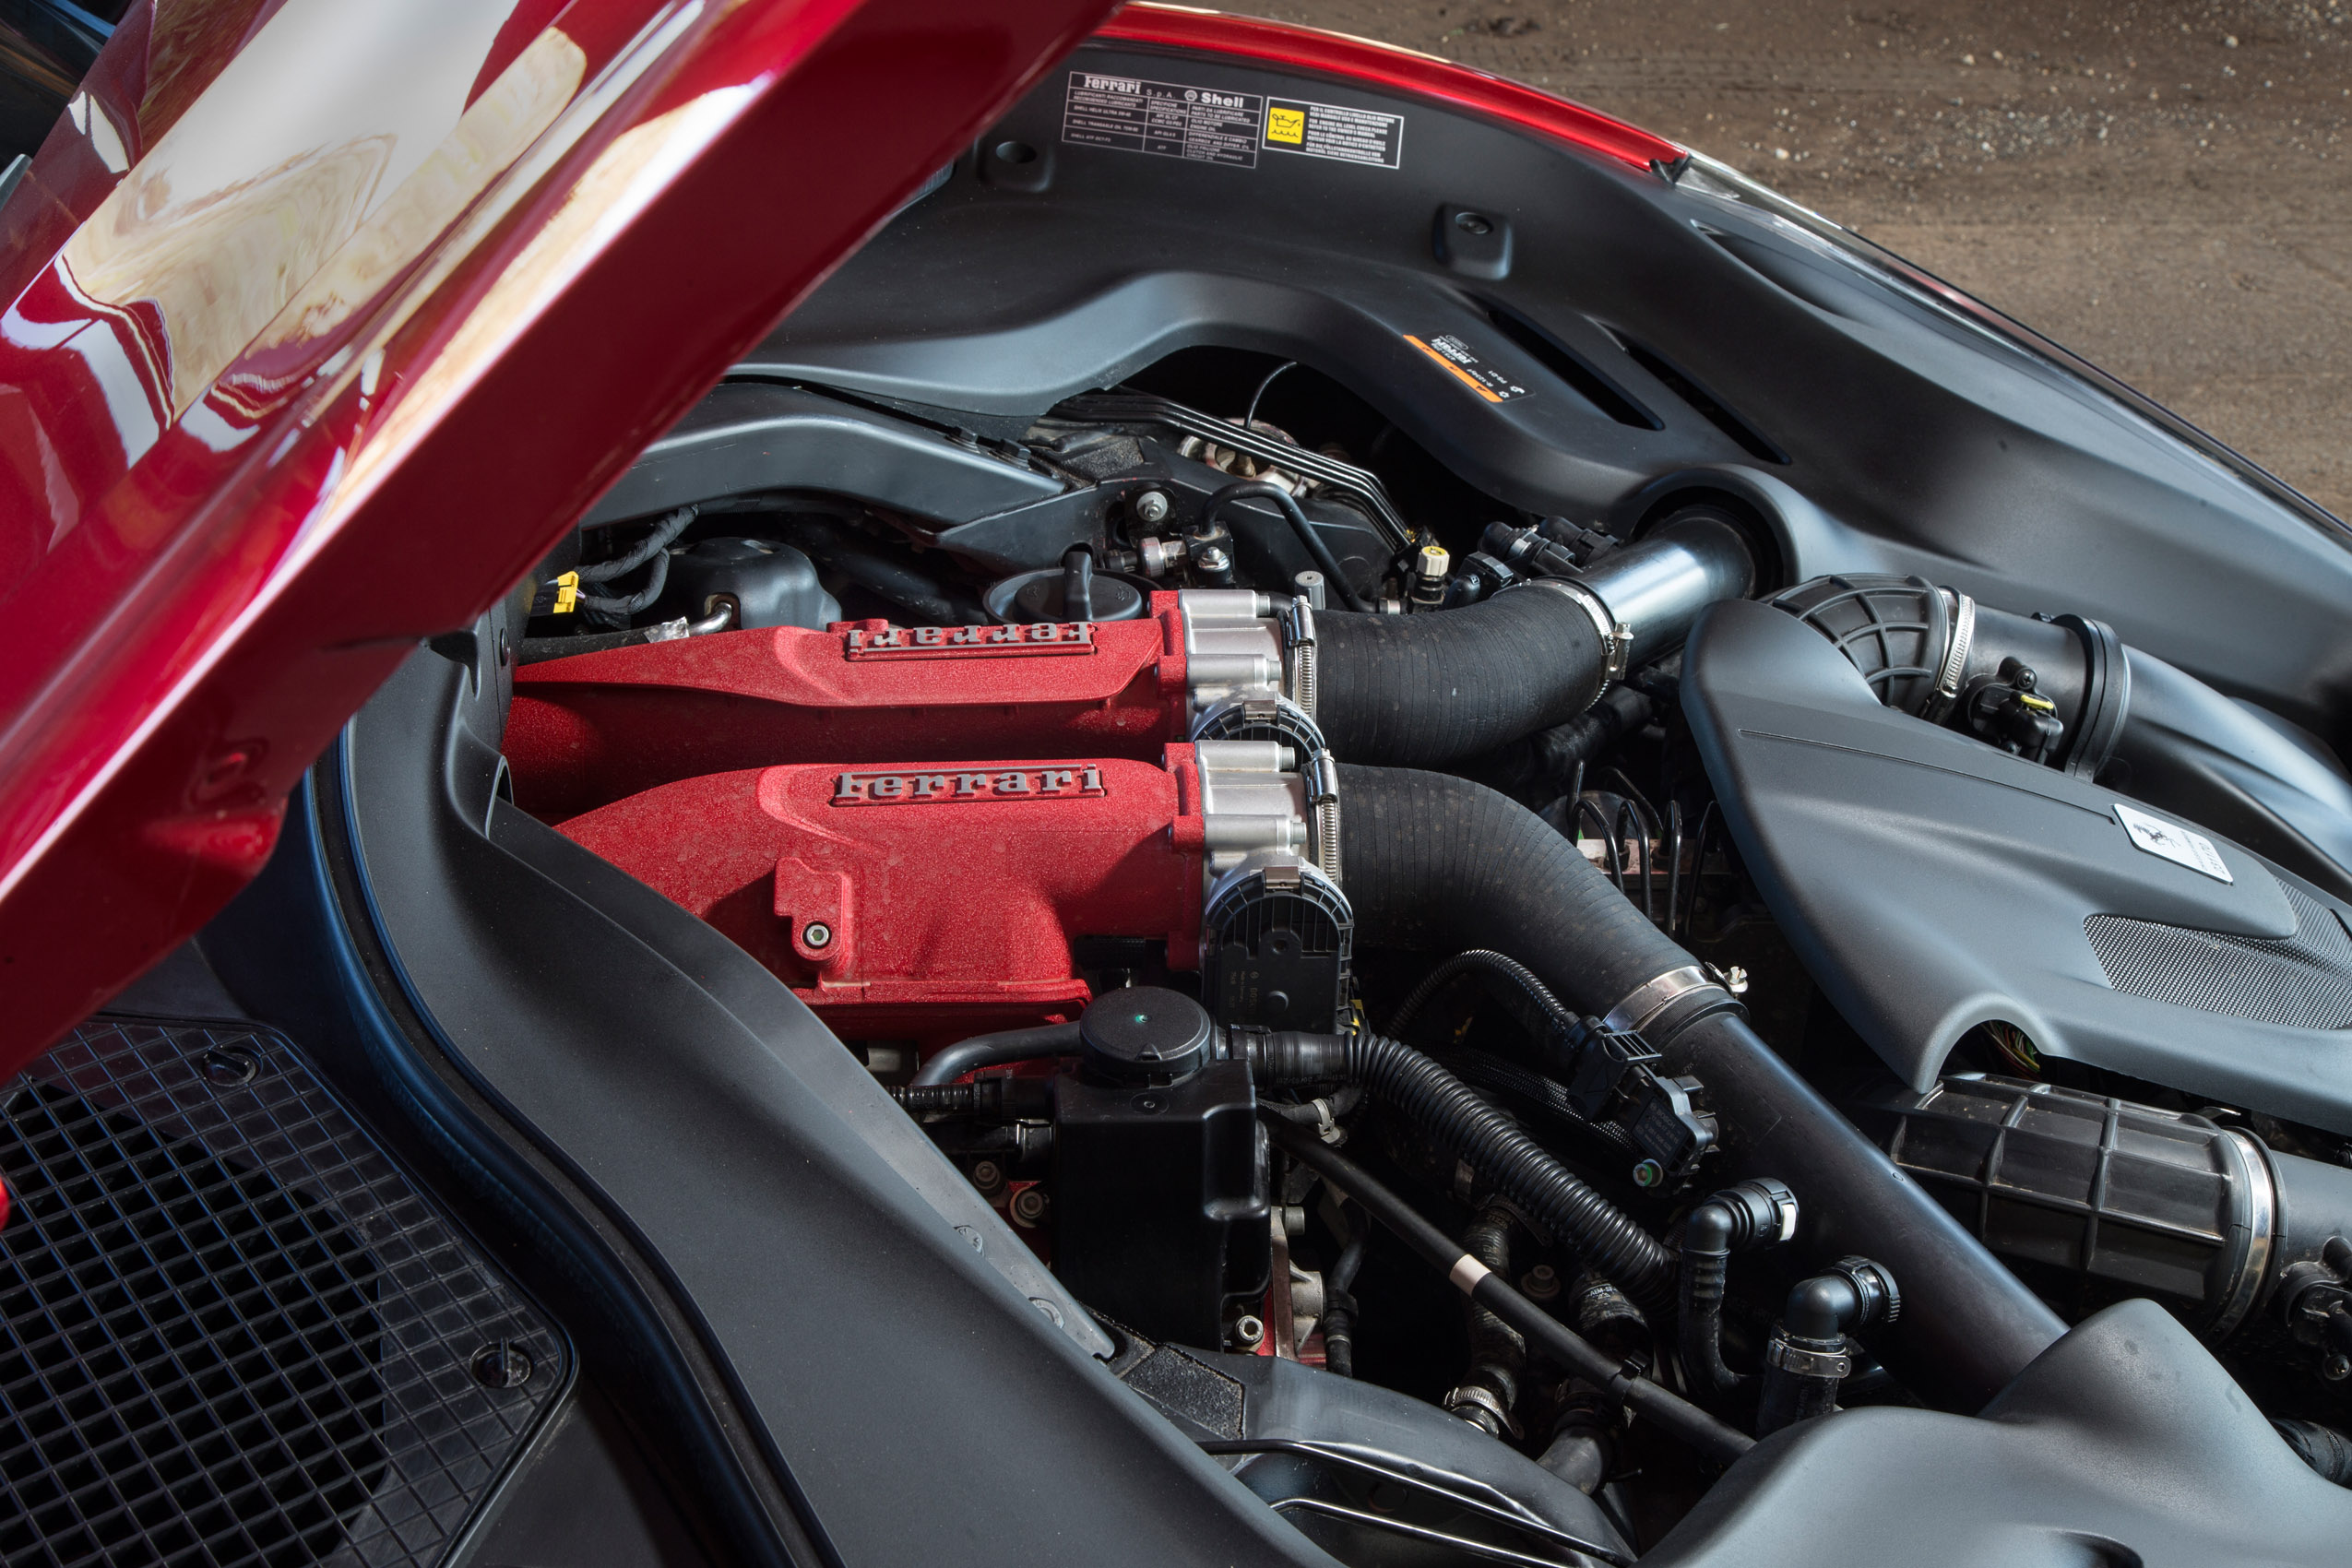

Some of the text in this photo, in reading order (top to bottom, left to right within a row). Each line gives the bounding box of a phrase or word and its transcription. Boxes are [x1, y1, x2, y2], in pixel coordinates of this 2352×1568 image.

[1084, 75, 1175, 100] Ferrari S.p.A.
[1201, 92, 1244, 108] Shell
[847, 622, 1094, 653] Ferrari
[837, 764, 1103, 798] Ferrari
